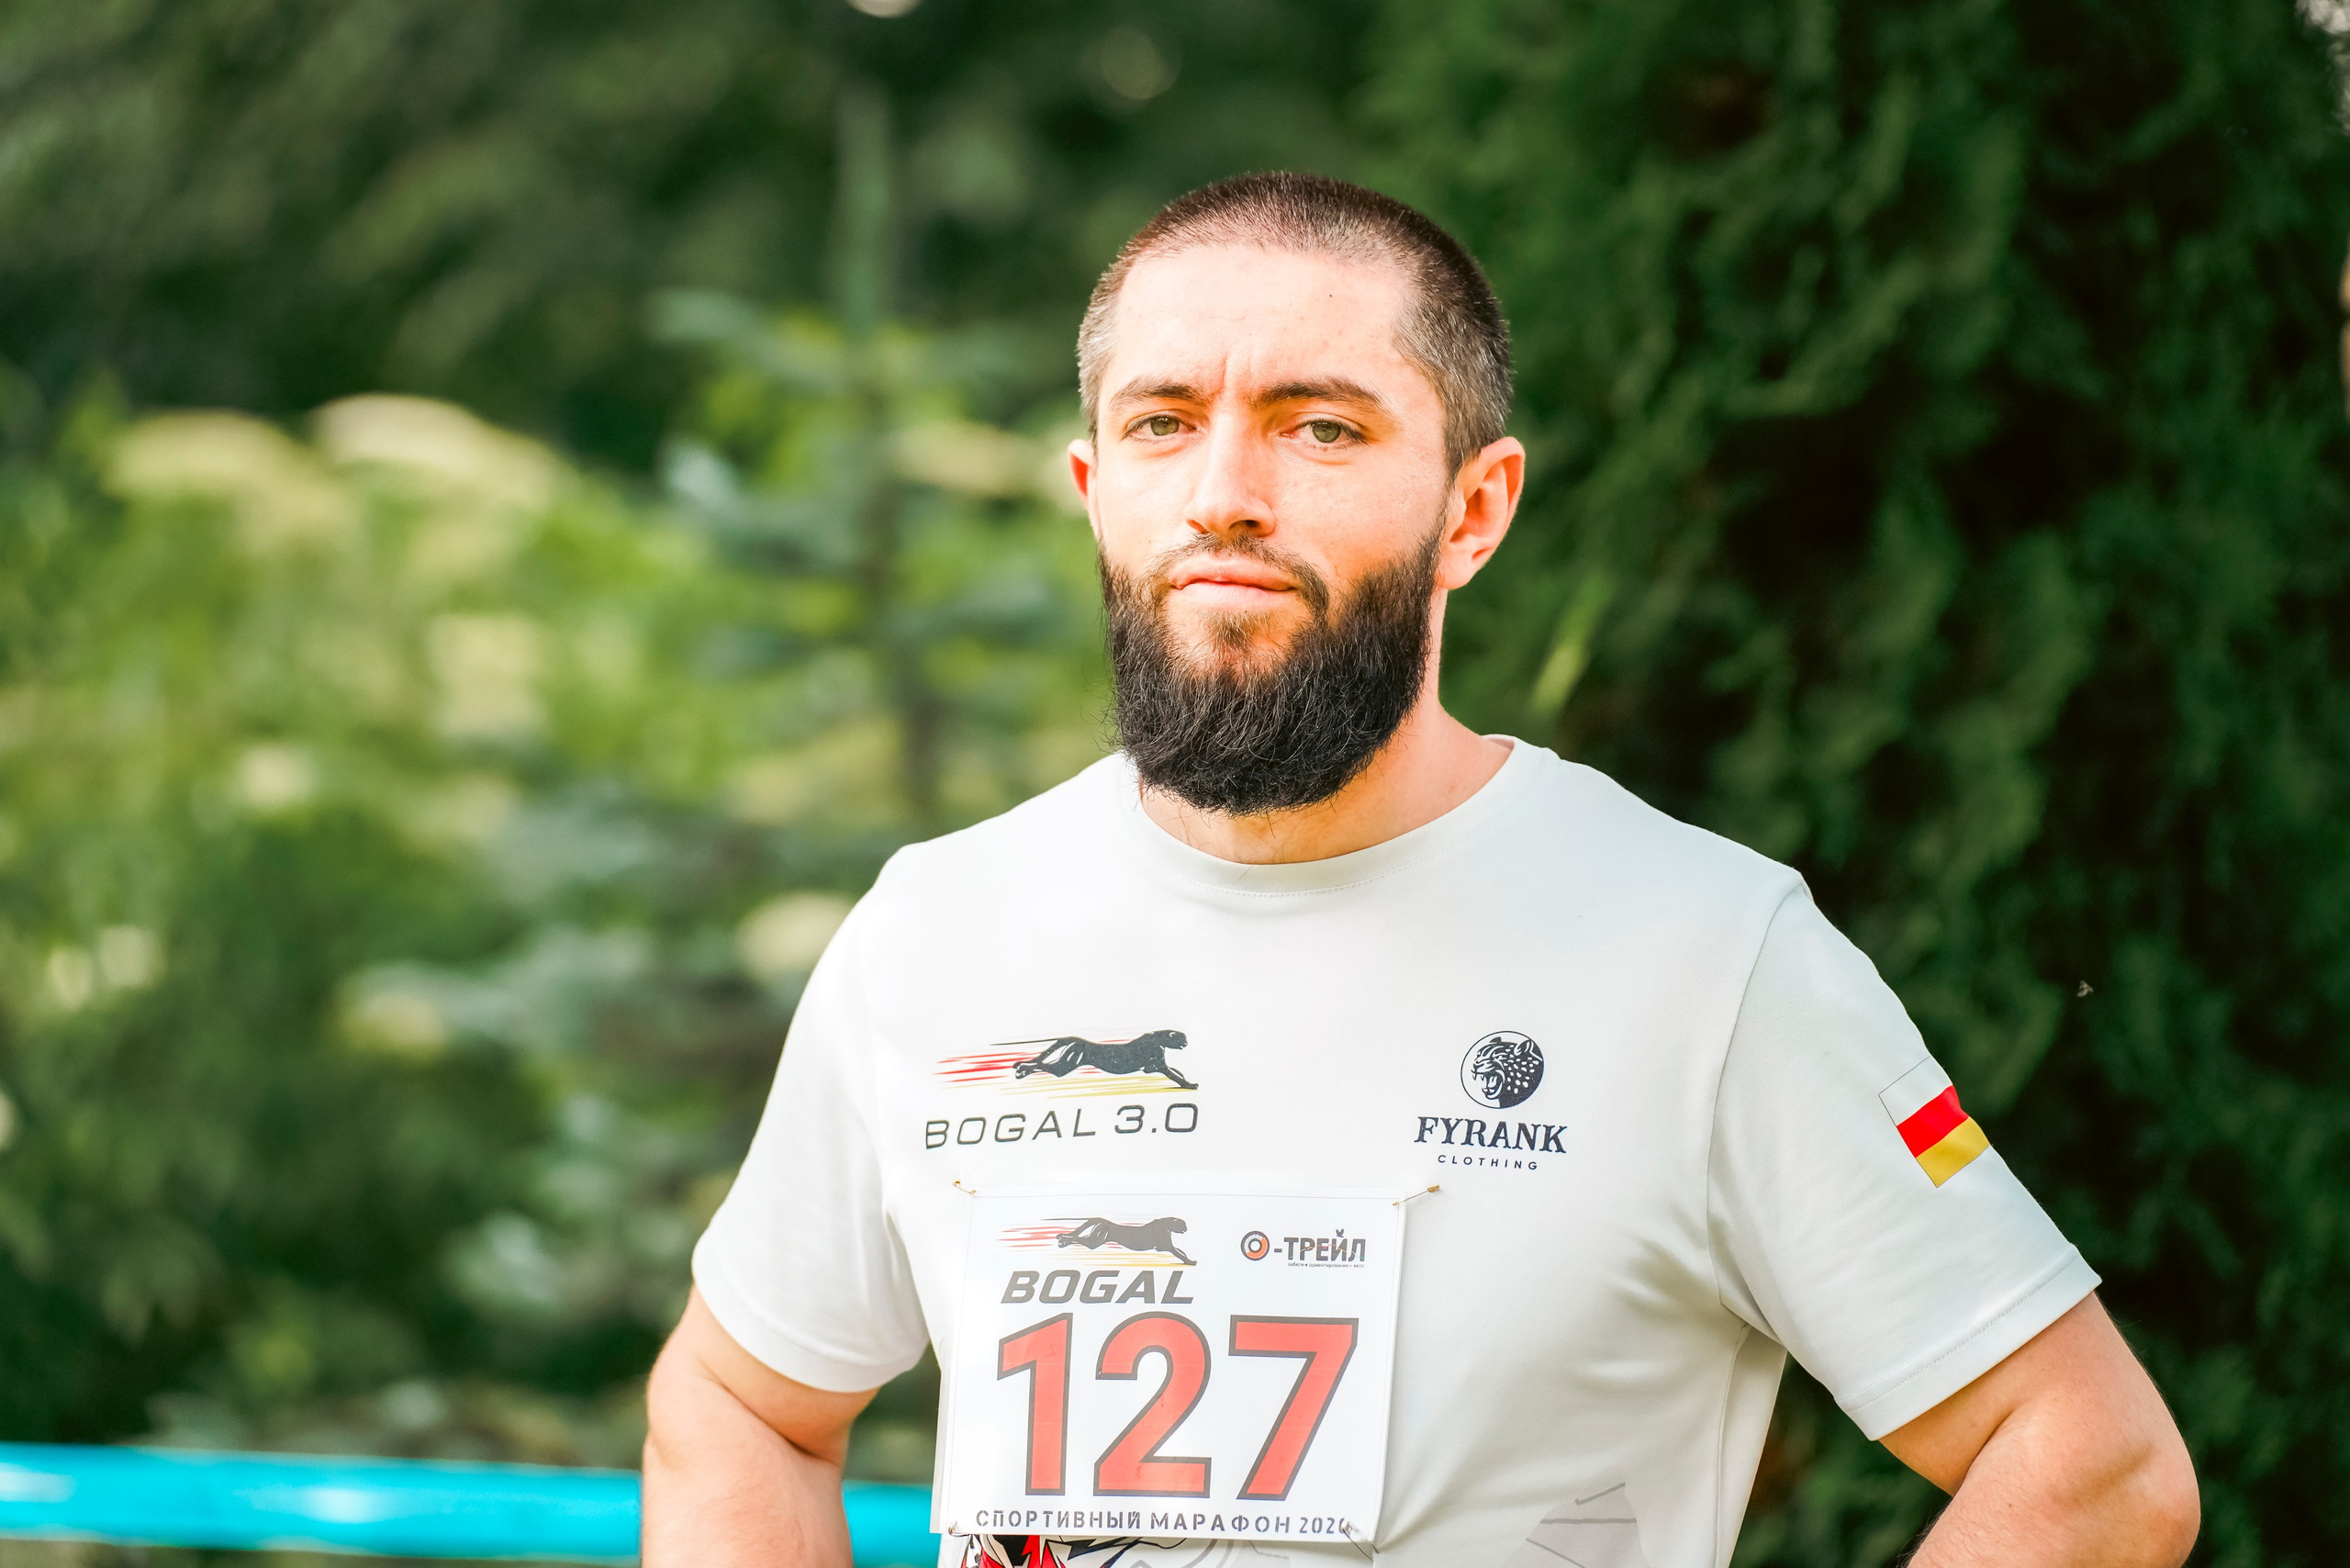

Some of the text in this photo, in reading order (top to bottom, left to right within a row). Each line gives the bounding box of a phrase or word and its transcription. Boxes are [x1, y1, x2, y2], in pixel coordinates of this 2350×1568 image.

[925, 1103, 1200, 1150] BOGAL 3.0
[1414, 1116, 1568, 1154] FYRANK
[1438, 1154, 1538, 1170] CLOTHING
[1001, 1270, 1194, 1305] BOGAL
[997, 1312, 1360, 1502] 127
[976, 1509, 1141, 1529] СПОРТИВНЫЙ
[1150, 1512, 1291, 1534] МАРАФОН
